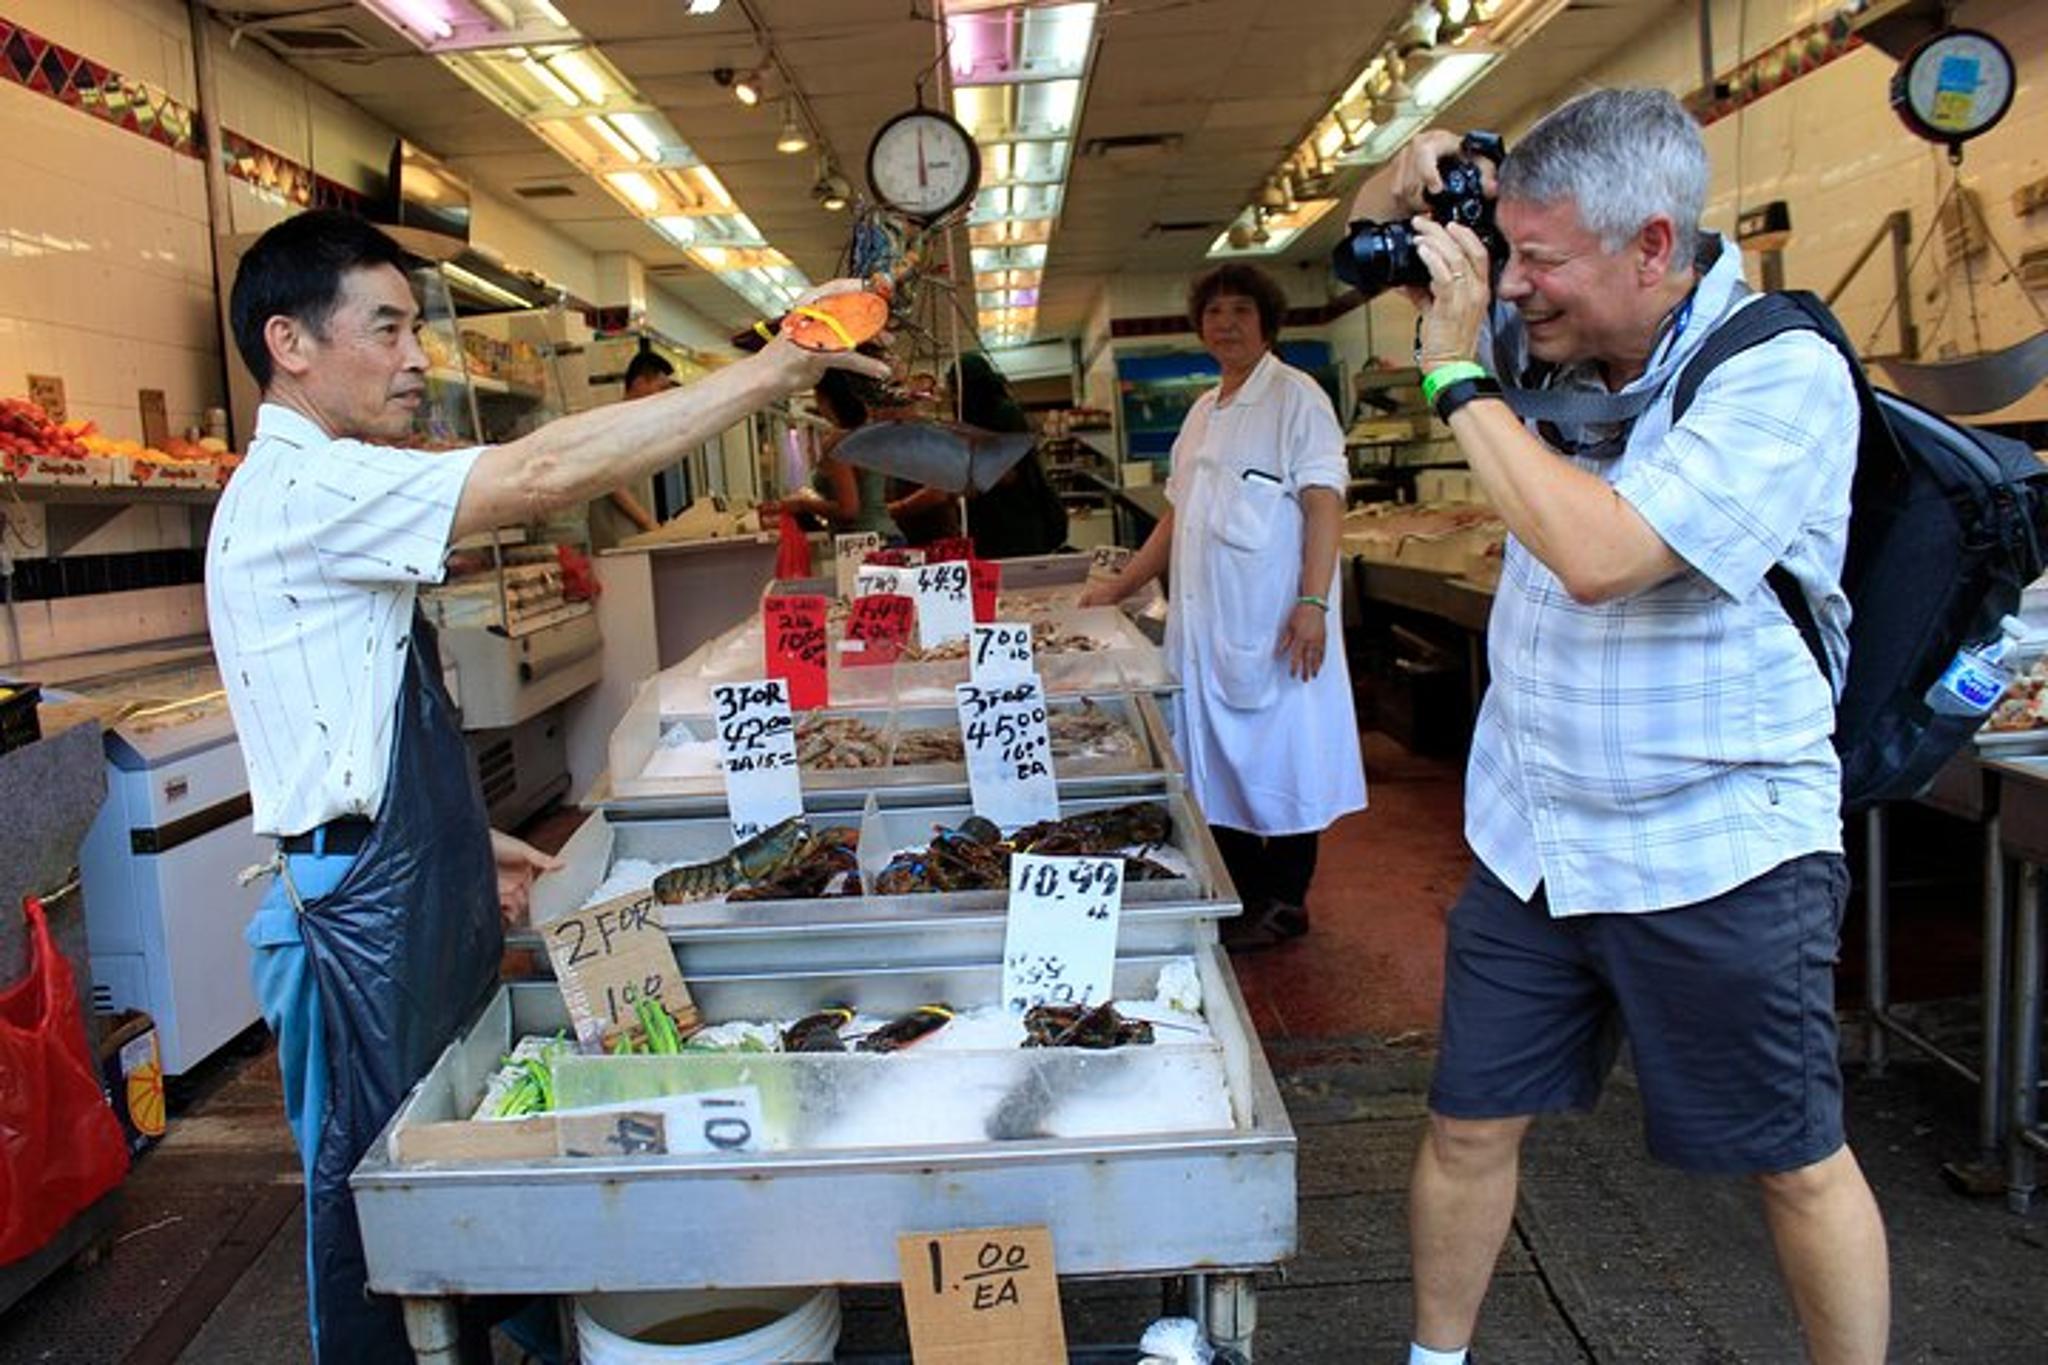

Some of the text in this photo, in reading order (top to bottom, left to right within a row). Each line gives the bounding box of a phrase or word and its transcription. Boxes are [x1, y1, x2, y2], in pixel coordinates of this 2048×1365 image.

[974, 627, 1028, 665] 7.00
[714, 682, 787, 721] 3 FOR
[958, 687, 988, 718] 3
[966, 707, 1046, 751] 45.00
[1016, 760, 1048, 780] EA
[1018, 859, 1119, 898] 10.99
[554, 896, 668, 966] 2 FOR
[928, 1240, 1027, 1295] 1.00
[972, 1276, 1019, 1310] EA
